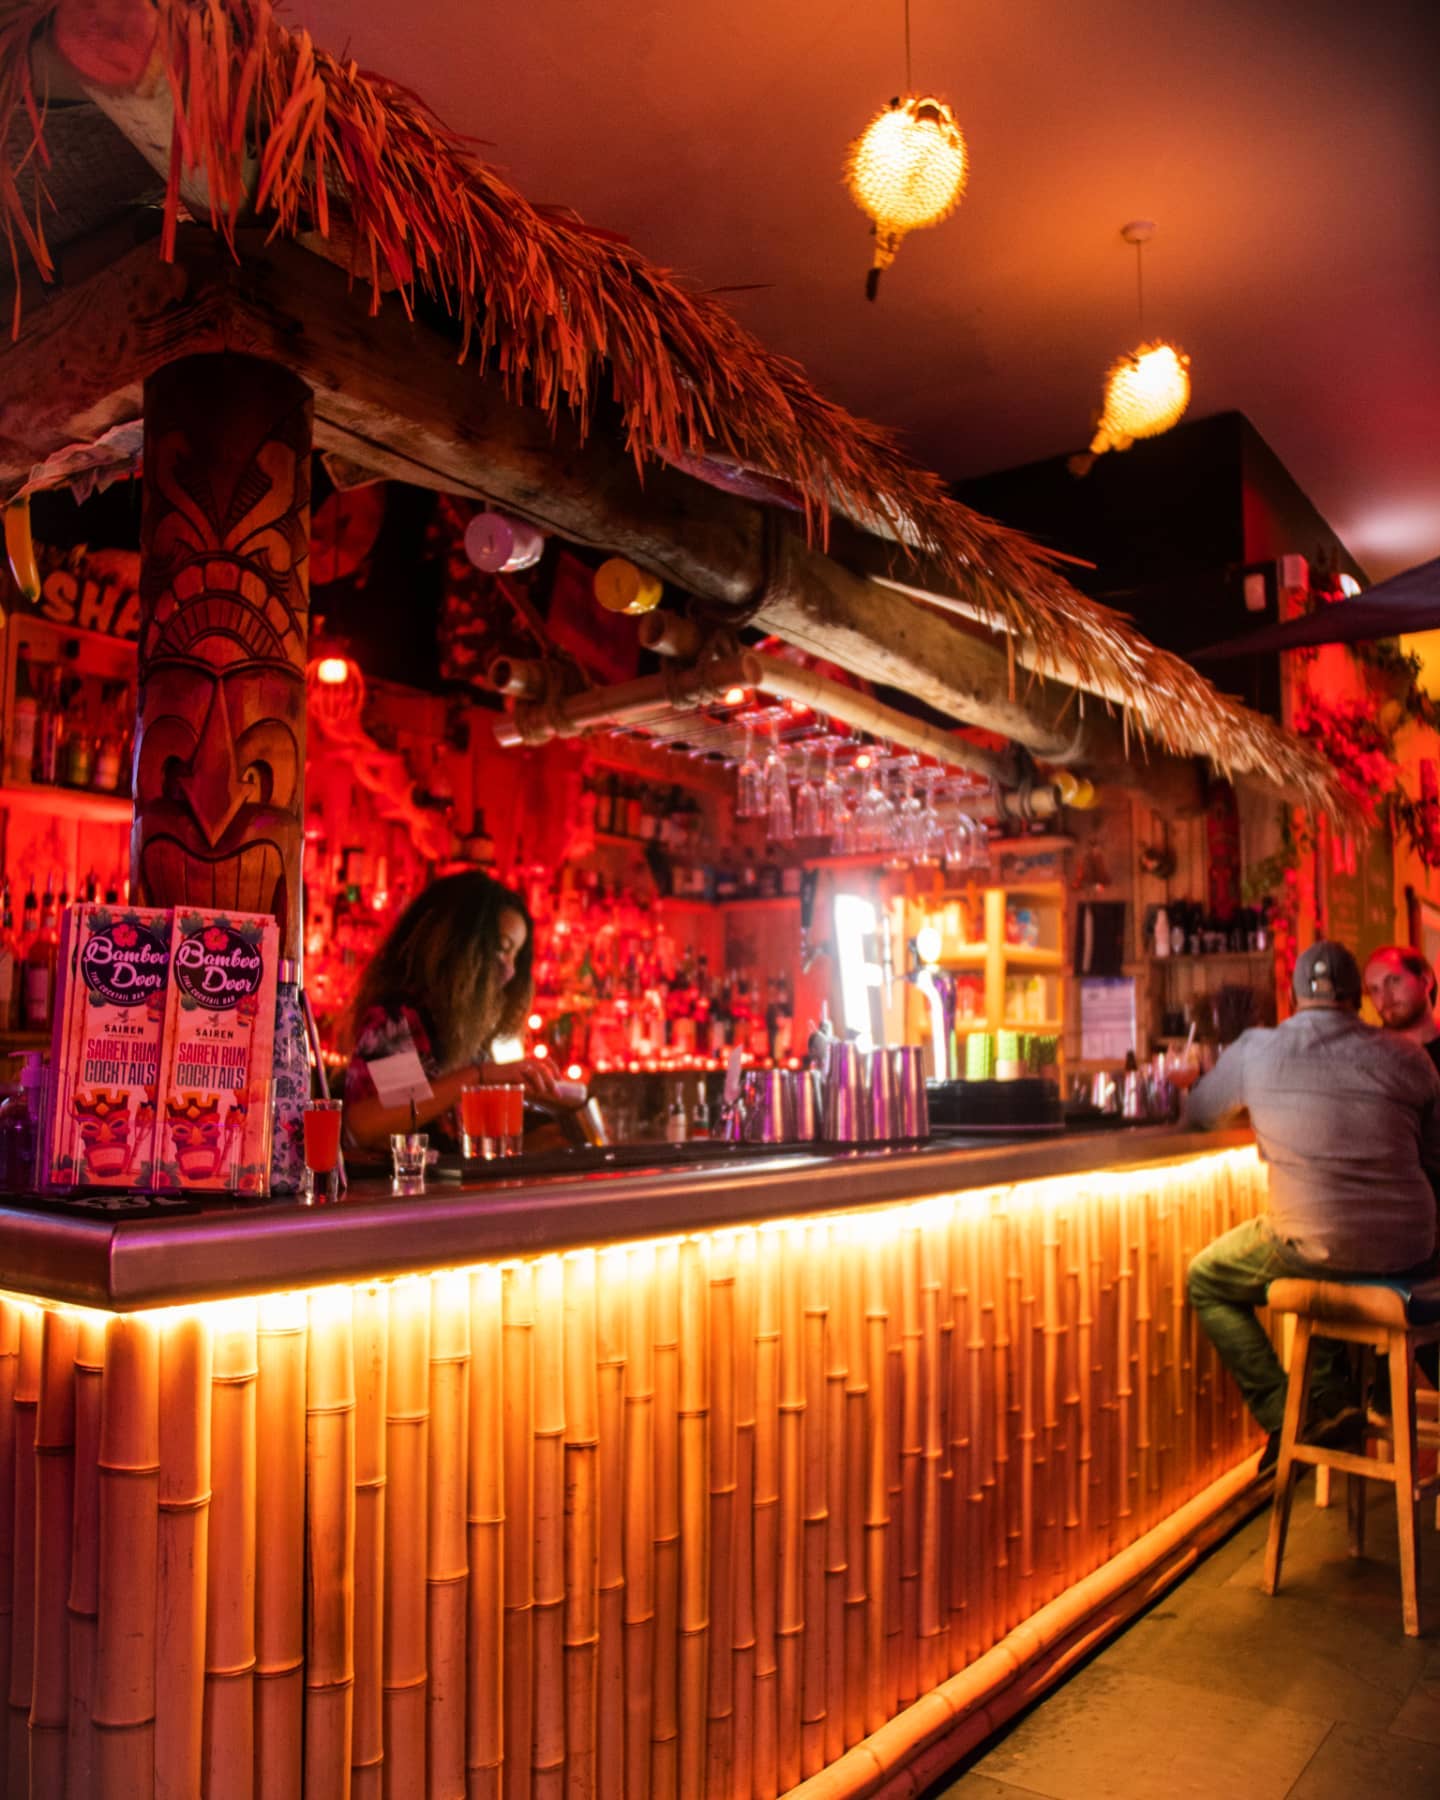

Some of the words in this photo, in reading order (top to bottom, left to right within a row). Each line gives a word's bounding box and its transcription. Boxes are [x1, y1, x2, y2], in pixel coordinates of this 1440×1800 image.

[83, 935, 169, 965] Bamboo
[176, 939, 260, 969] Bamboo
[110, 961, 161, 988] Door
[202, 966, 251, 992] Door
[99, 984, 129, 1001] COCKTAIL
[104, 1023, 144, 1035] SAIREN
[195, 1028, 234, 1039] SAIREN
[87, 1038, 129, 1061] SAIREN
[131, 1041, 157, 1062] RUM
[178, 1042, 219, 1065] SAIREN
[221, 1045, 247, 1067] RUM
[84, 1059, 156, 1086] COCKTAILS
[176, 1063, 245, 1090] COCKTAILS
